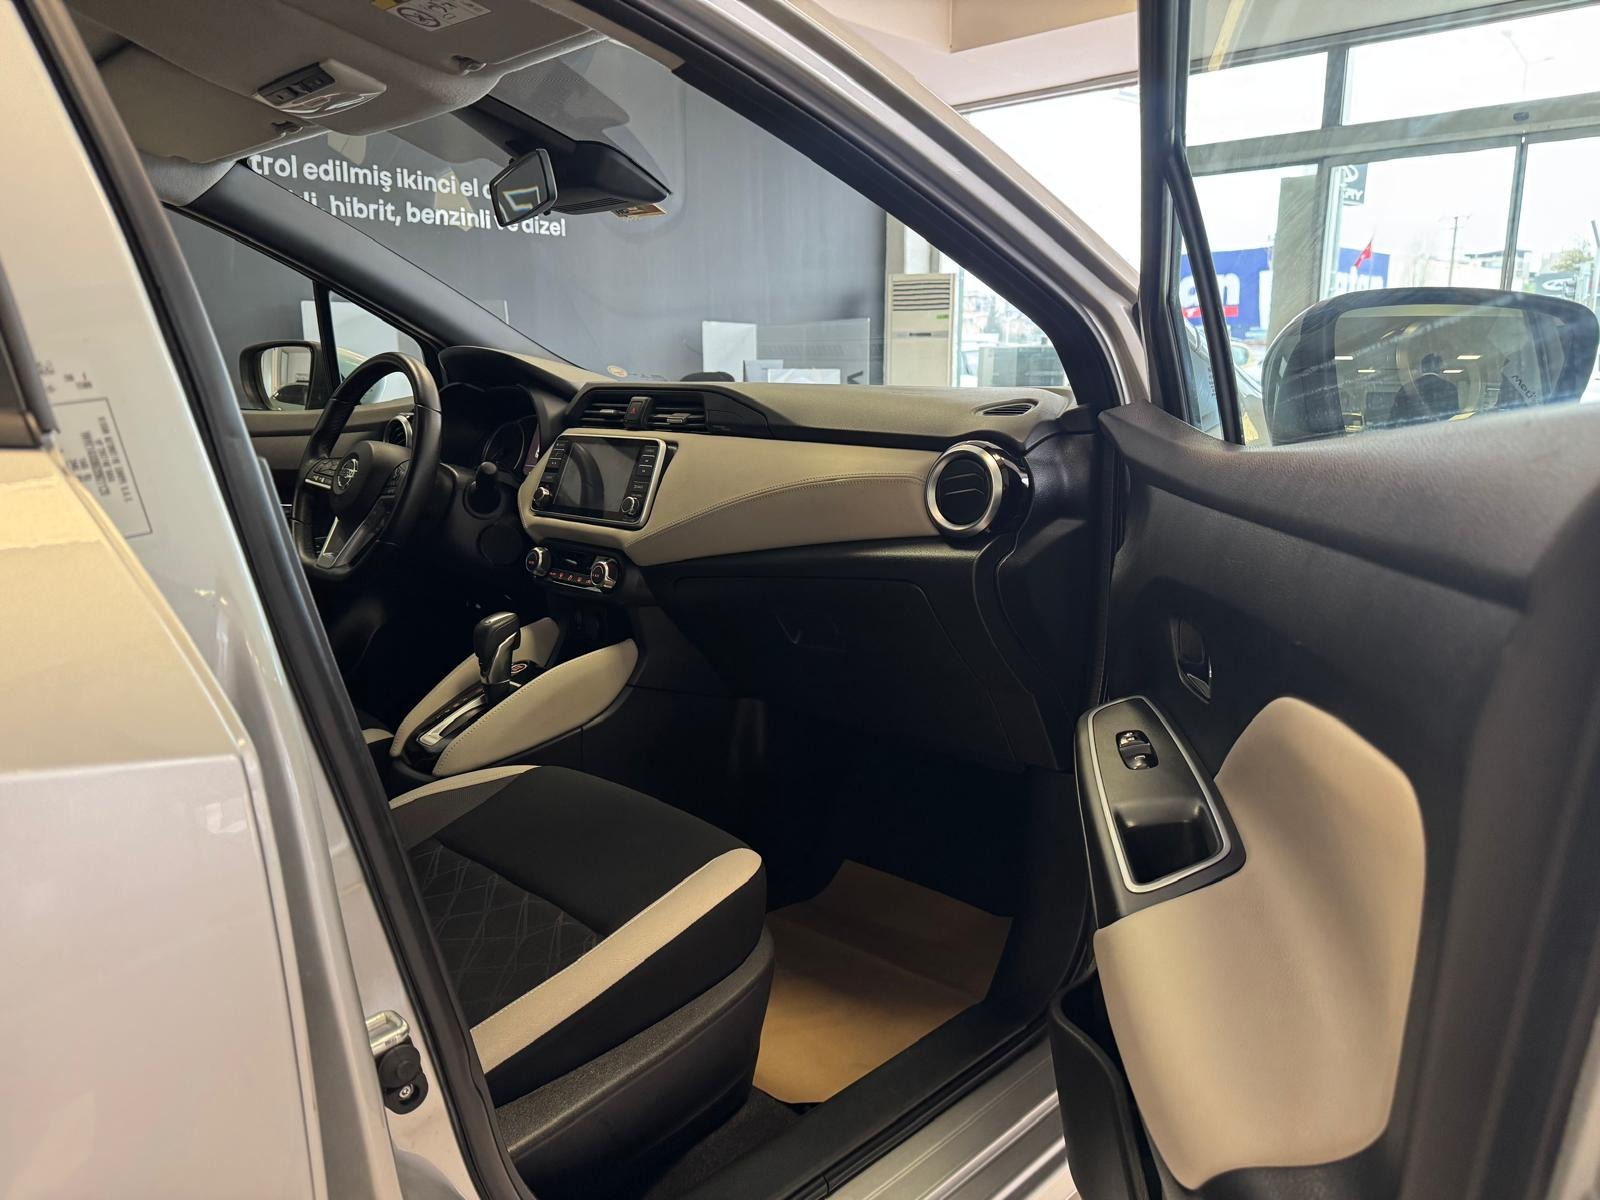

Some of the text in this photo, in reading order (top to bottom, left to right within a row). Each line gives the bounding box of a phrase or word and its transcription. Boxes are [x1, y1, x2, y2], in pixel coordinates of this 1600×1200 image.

[302, 159, 392, 192] edilmiş
[396, 167, 457, 195] ikinci
[460, 178, 479, 198] el
[329, 194, 402, 227] hibrit,
[406, 201, 491, 230] benzinli
[522, 215, 567, 237] dizel
